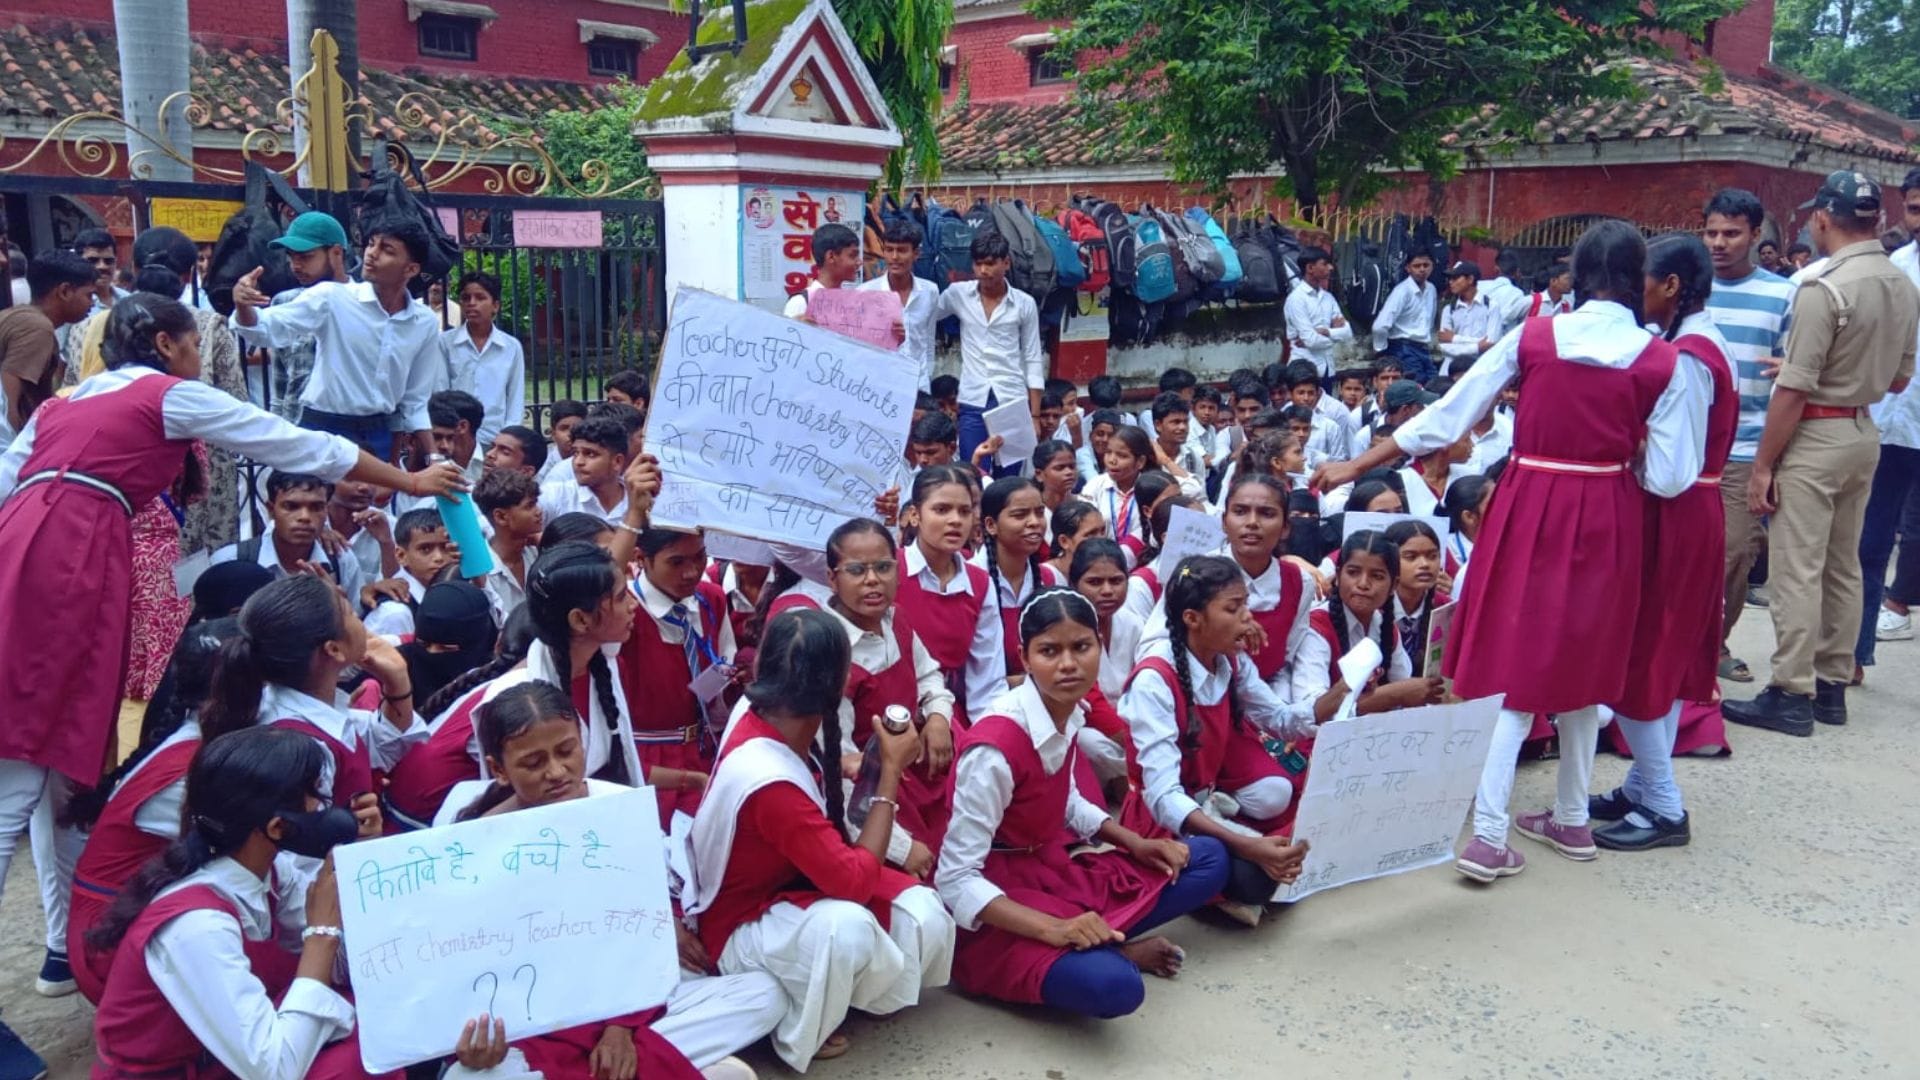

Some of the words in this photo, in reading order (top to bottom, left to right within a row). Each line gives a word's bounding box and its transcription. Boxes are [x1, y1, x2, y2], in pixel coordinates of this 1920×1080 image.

[783, 192, 821, 229] से
[664, 361, 708, 409] की
[709, 374, 752, 416] बात
[675, 316, 760, 362] Teacher
[759, 327, 809, 373] सुनो
[807, 352, 899, 419] Students
[660, 423, 689, 470] दो
[700, 422, 764, 468] हमारे
[354, 845, 441, 913] किताबे
[502, 827, 570, 874] बच्चे
[517, 911, 598, 944] Teacher
